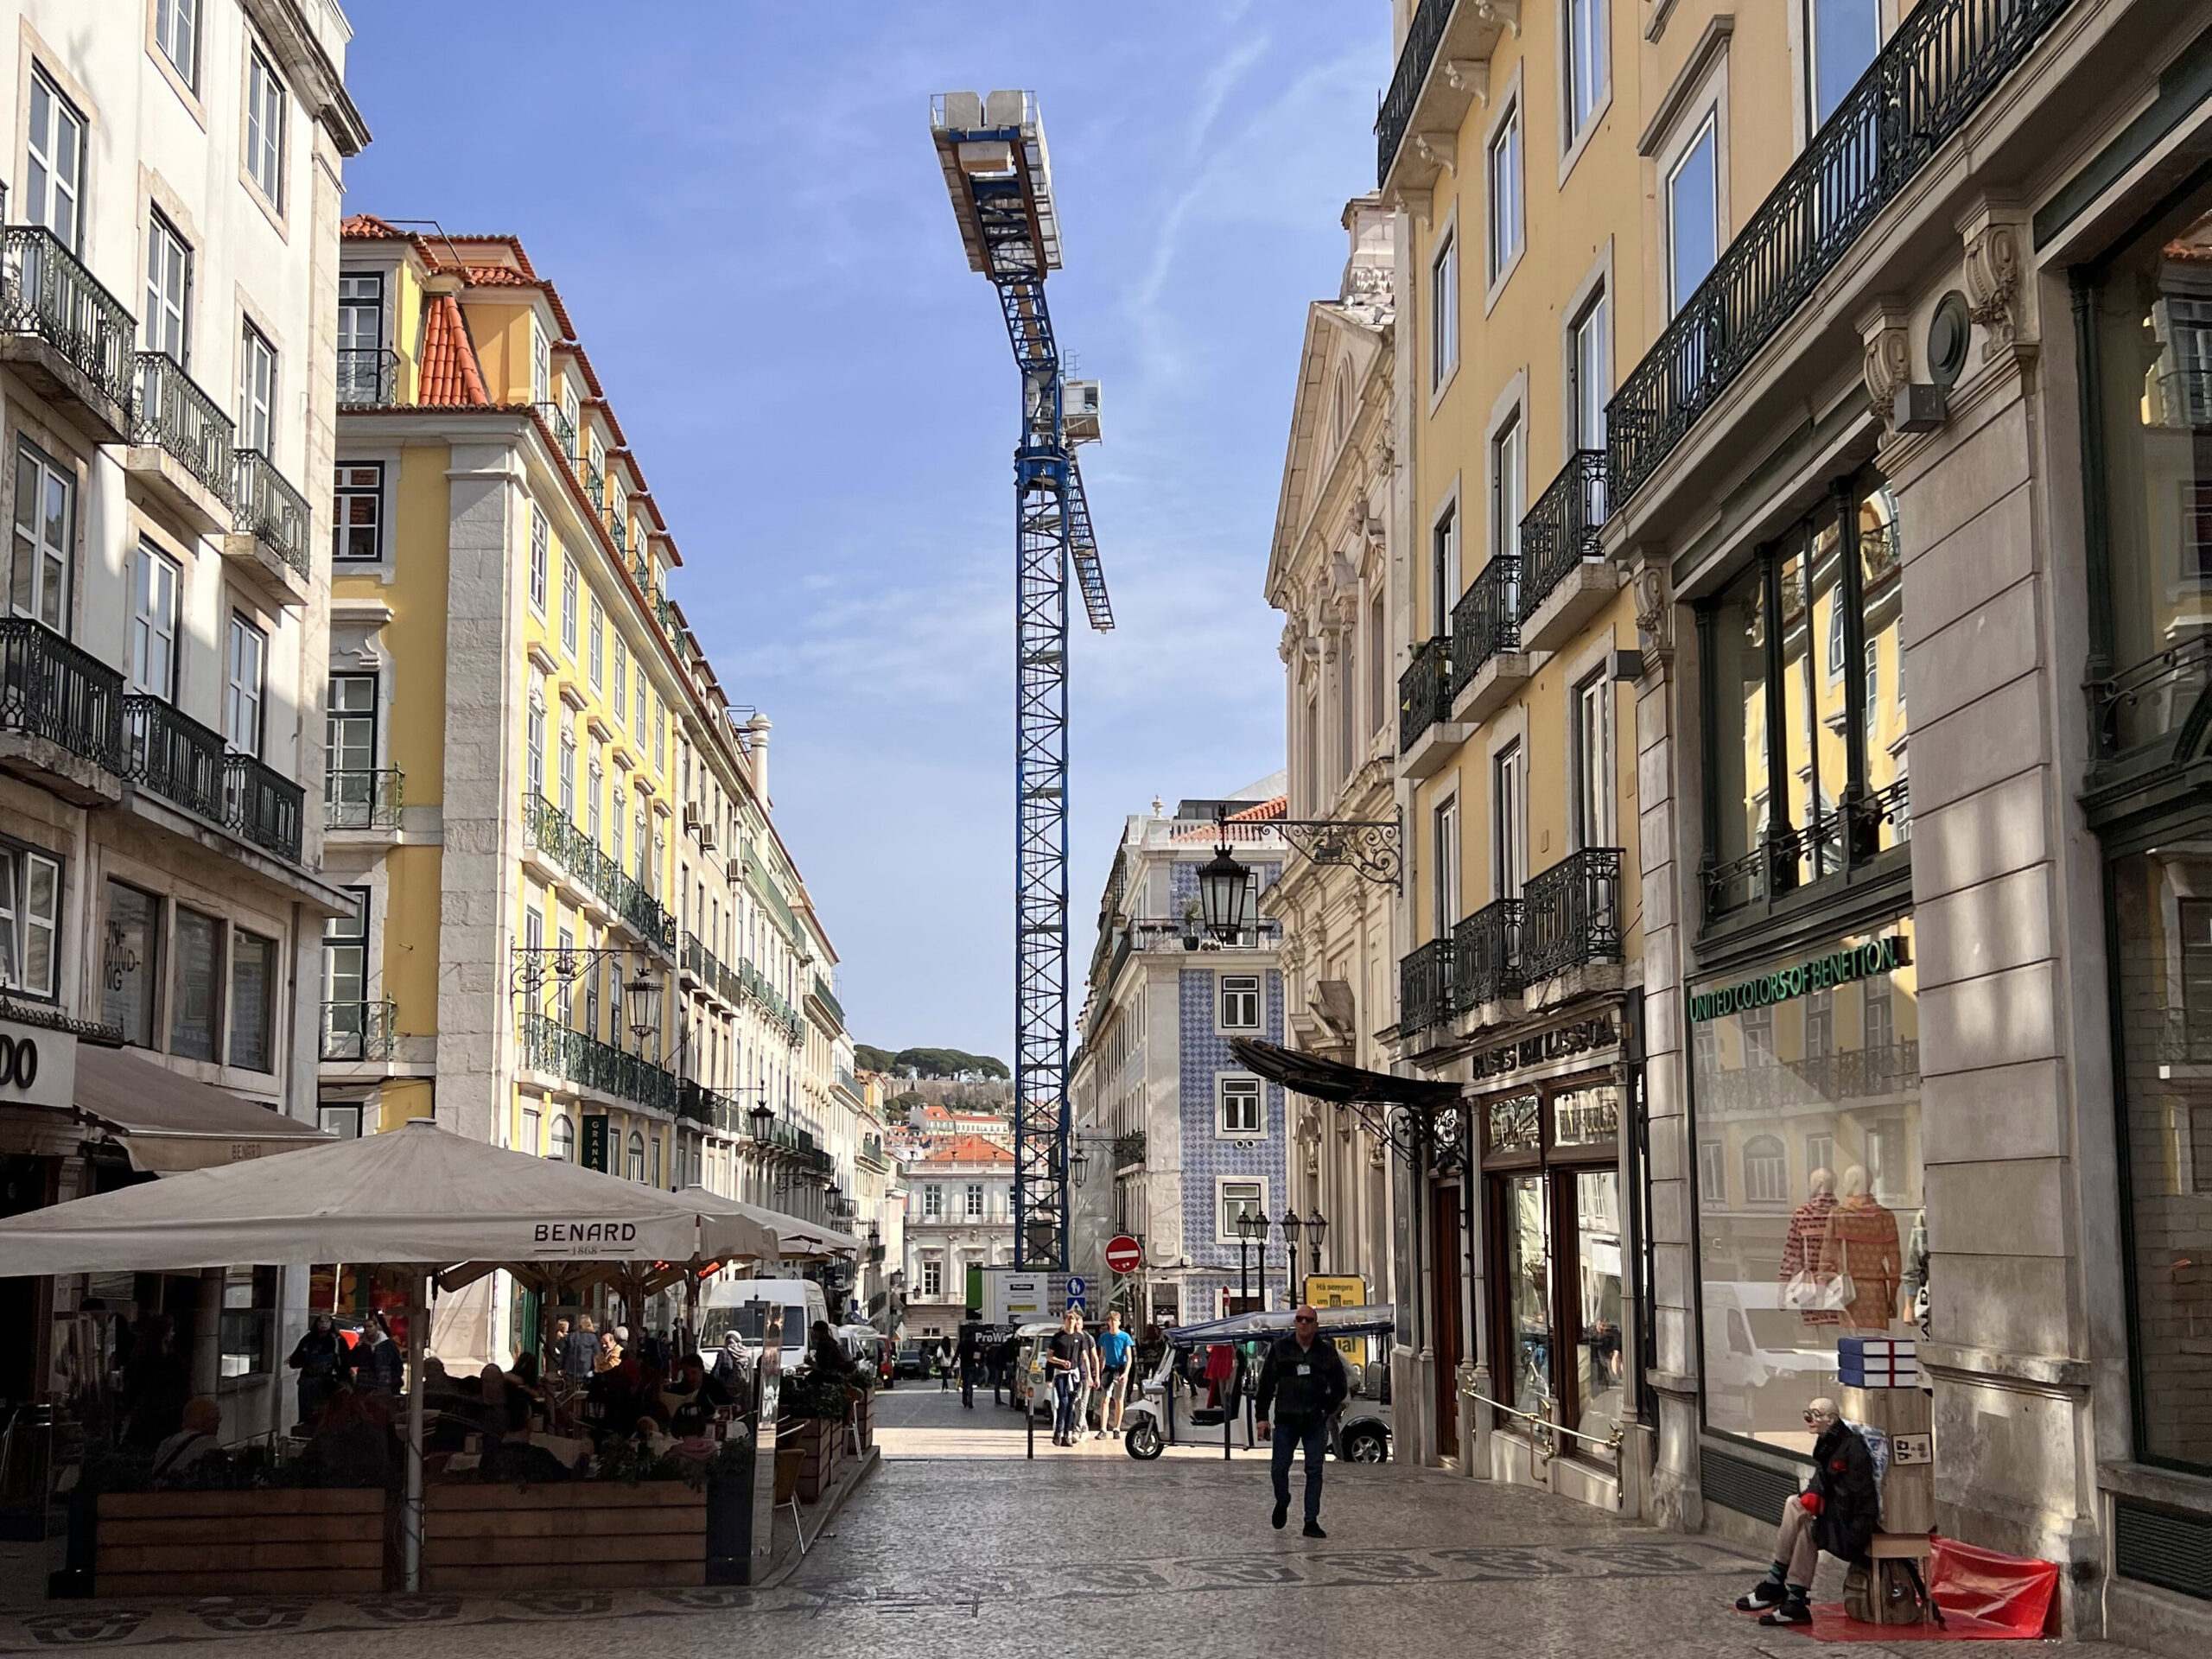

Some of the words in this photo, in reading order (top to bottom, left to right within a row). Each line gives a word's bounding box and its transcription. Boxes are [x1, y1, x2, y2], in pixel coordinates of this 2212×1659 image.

[1688, 988, 1733, 1021] UNITED
[1734, 972, 1788, 1010] COLORS
[1789, 963, 1809, 995] OF
[534, 1223, 636, 1242] BENARD
[571, 1246, 598, 1256] 1868
[1316, 1282, 1326, 1291] Há
[1327, 1284, 1354, 1293] sempre
